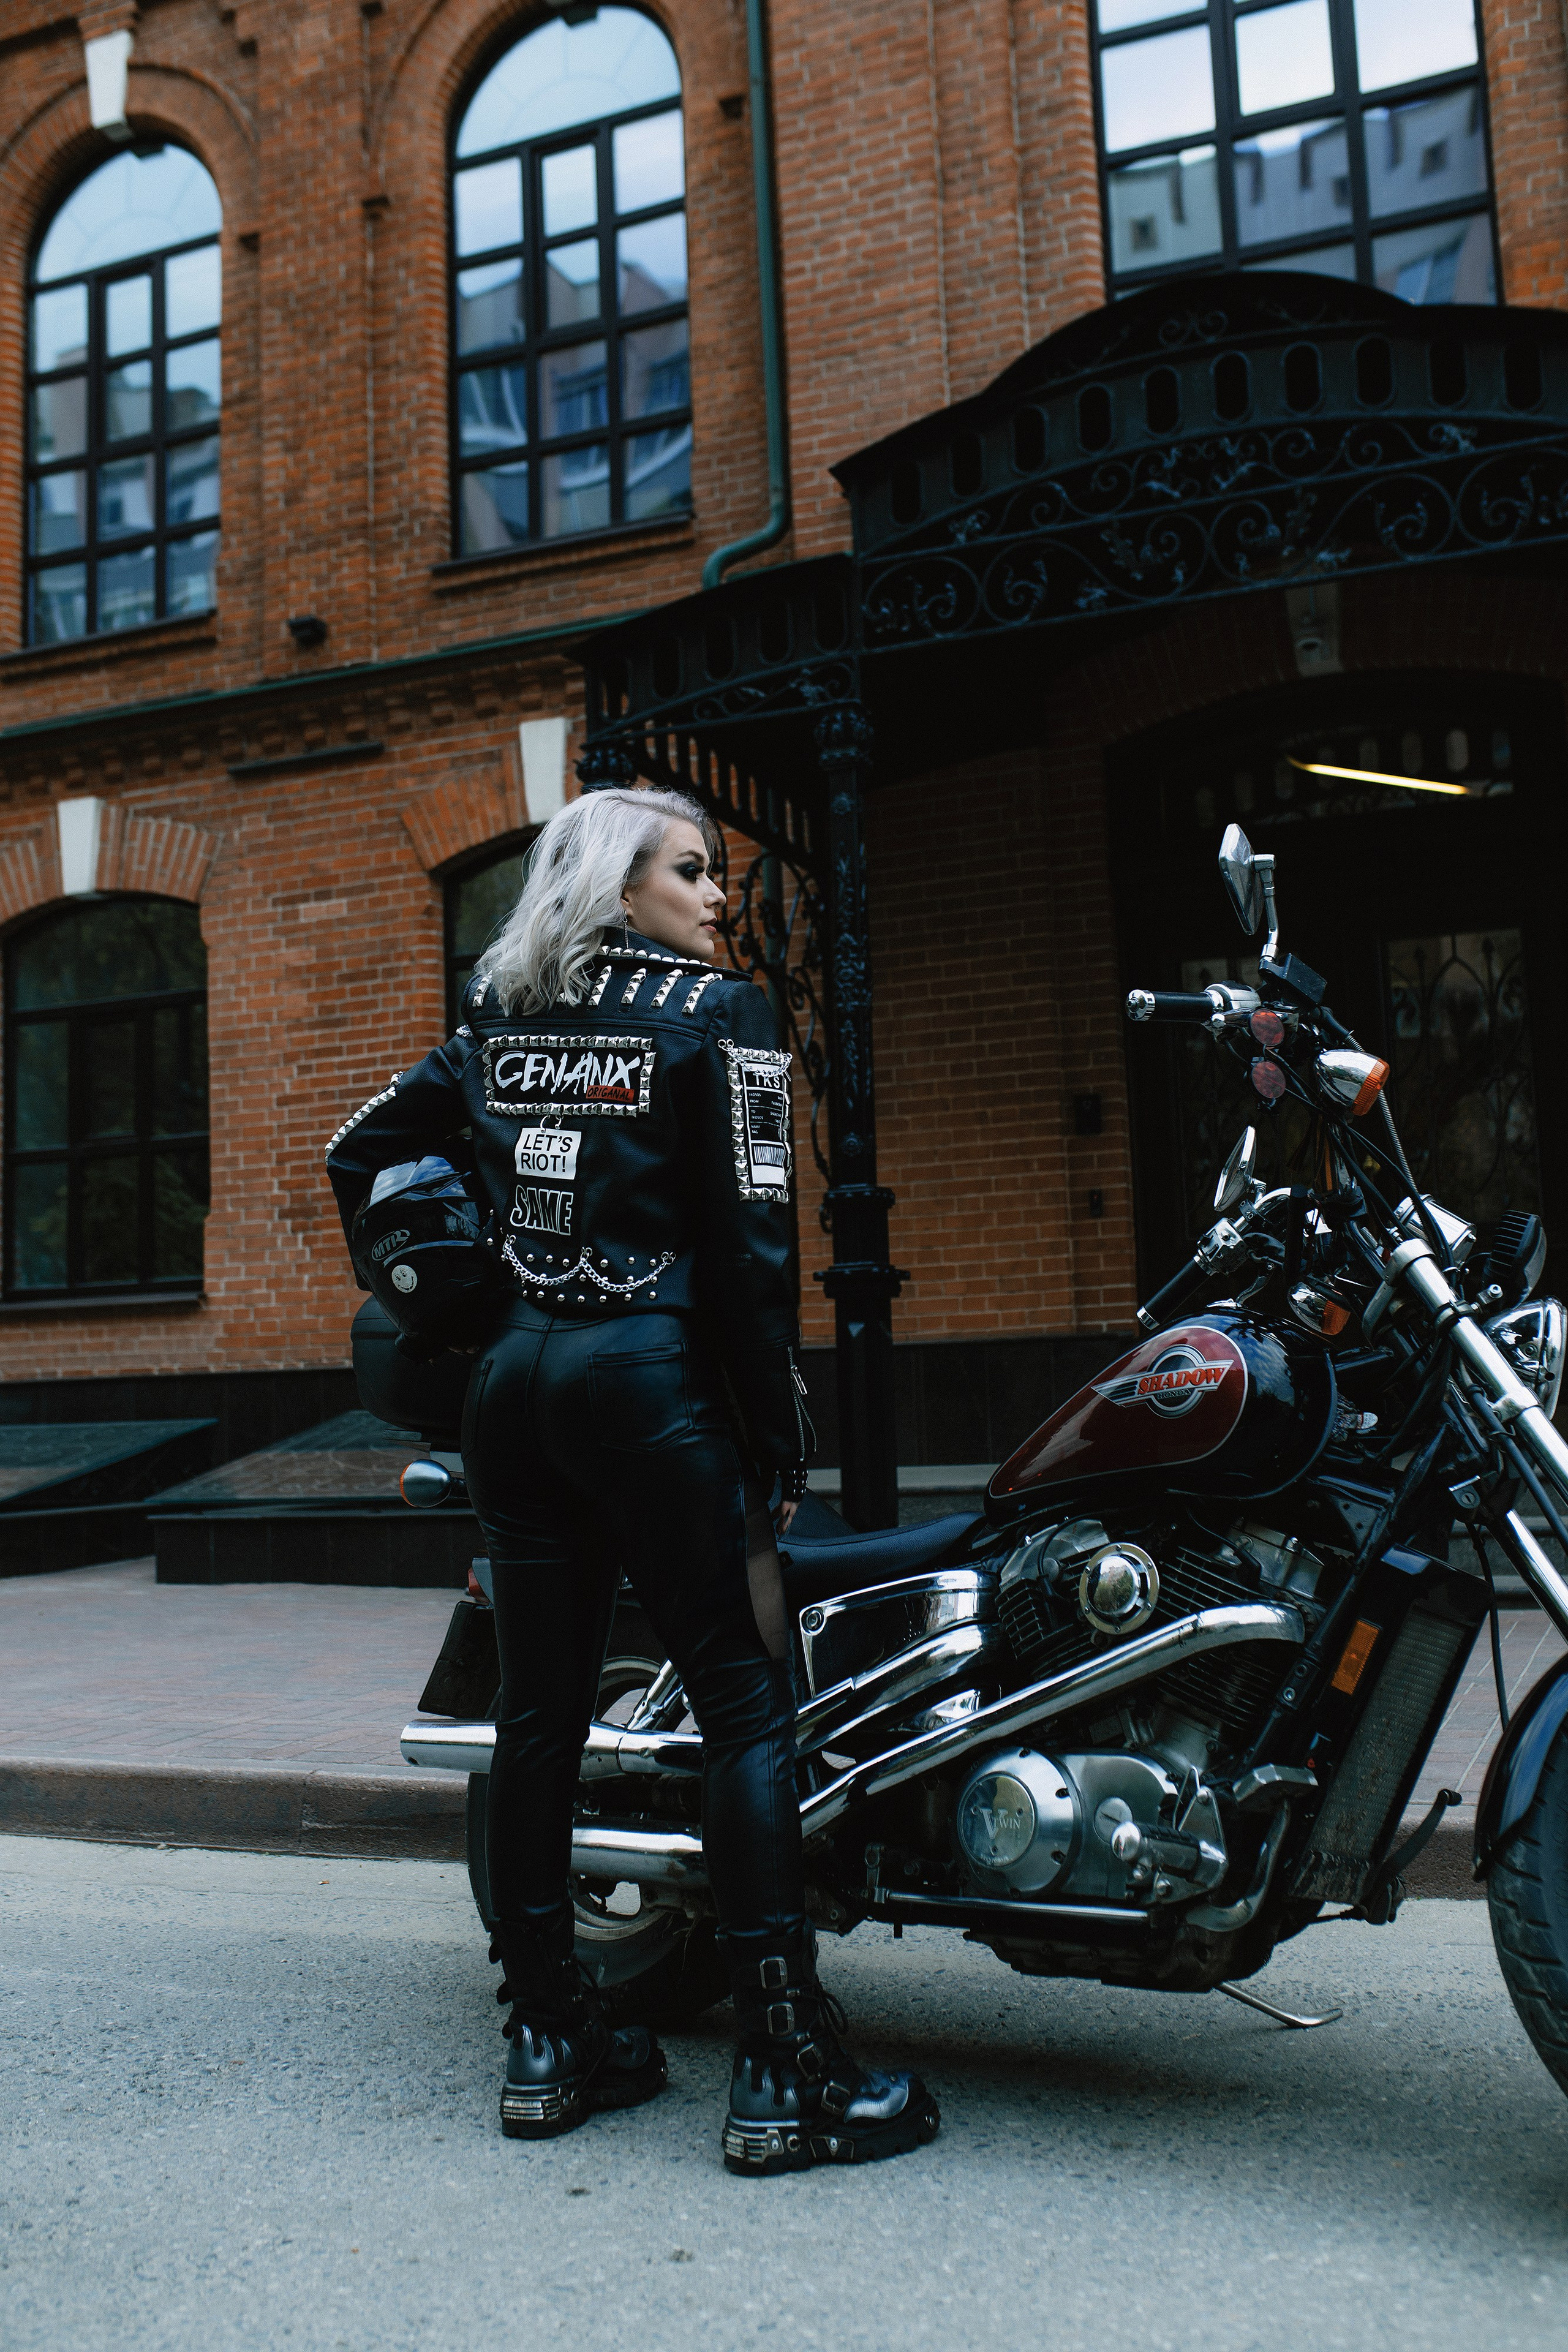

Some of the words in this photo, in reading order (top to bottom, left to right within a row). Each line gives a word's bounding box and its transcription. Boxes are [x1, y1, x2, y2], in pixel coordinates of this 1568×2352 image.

[753, 1072, 780, 1088] TKS
[587, 1087, 630, 1101] ORIGANAL
[522, 1133, 573, 1153] LET'S
[521, 1153, 566, 1173] RIOT!
[510, 1184, 574, 1236] SAME
[1137, 1366, 1225, 1395] SHADOW
